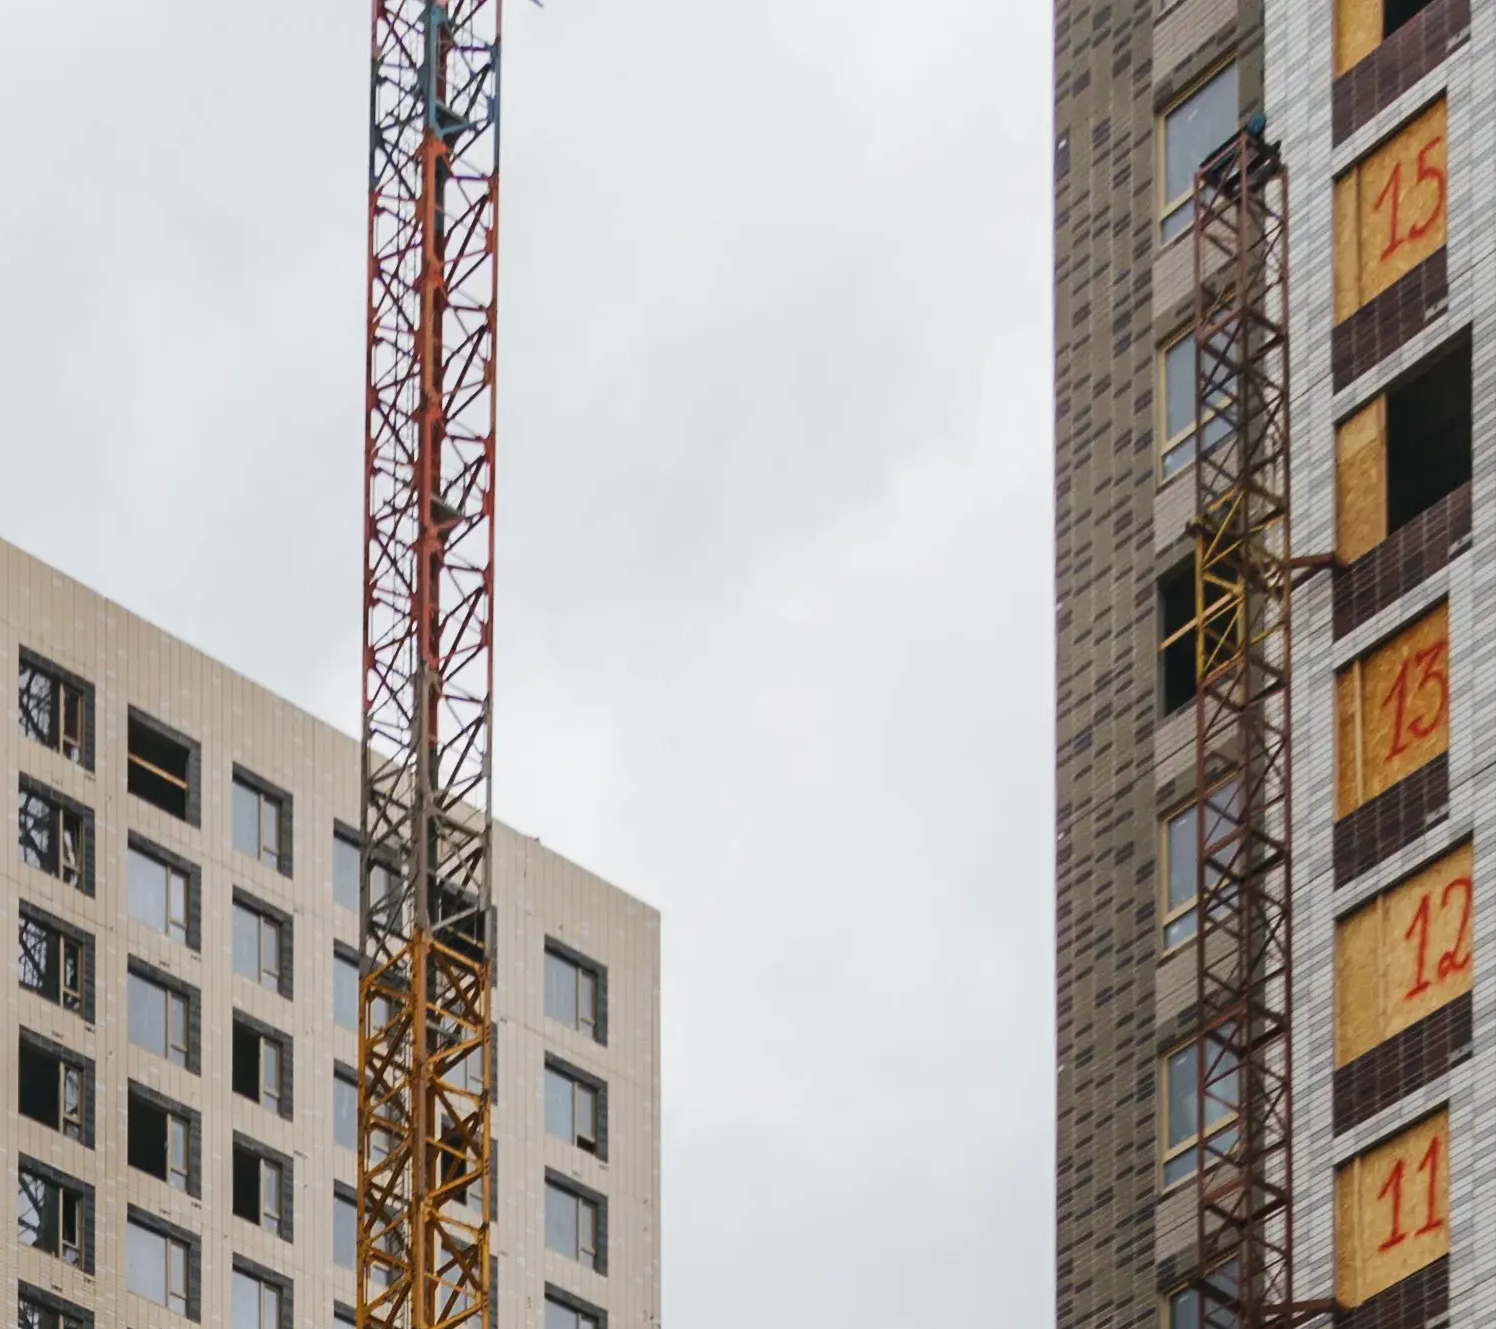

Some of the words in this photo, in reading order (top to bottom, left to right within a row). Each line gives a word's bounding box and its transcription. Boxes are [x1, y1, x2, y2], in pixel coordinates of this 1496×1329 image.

[1373, 136, 1446, 262] 15
[1381, 641, 1449, 763] 13
[1404, 876, 1473, 1001] 12
[1377, 1135, 1445, 1253] 11
